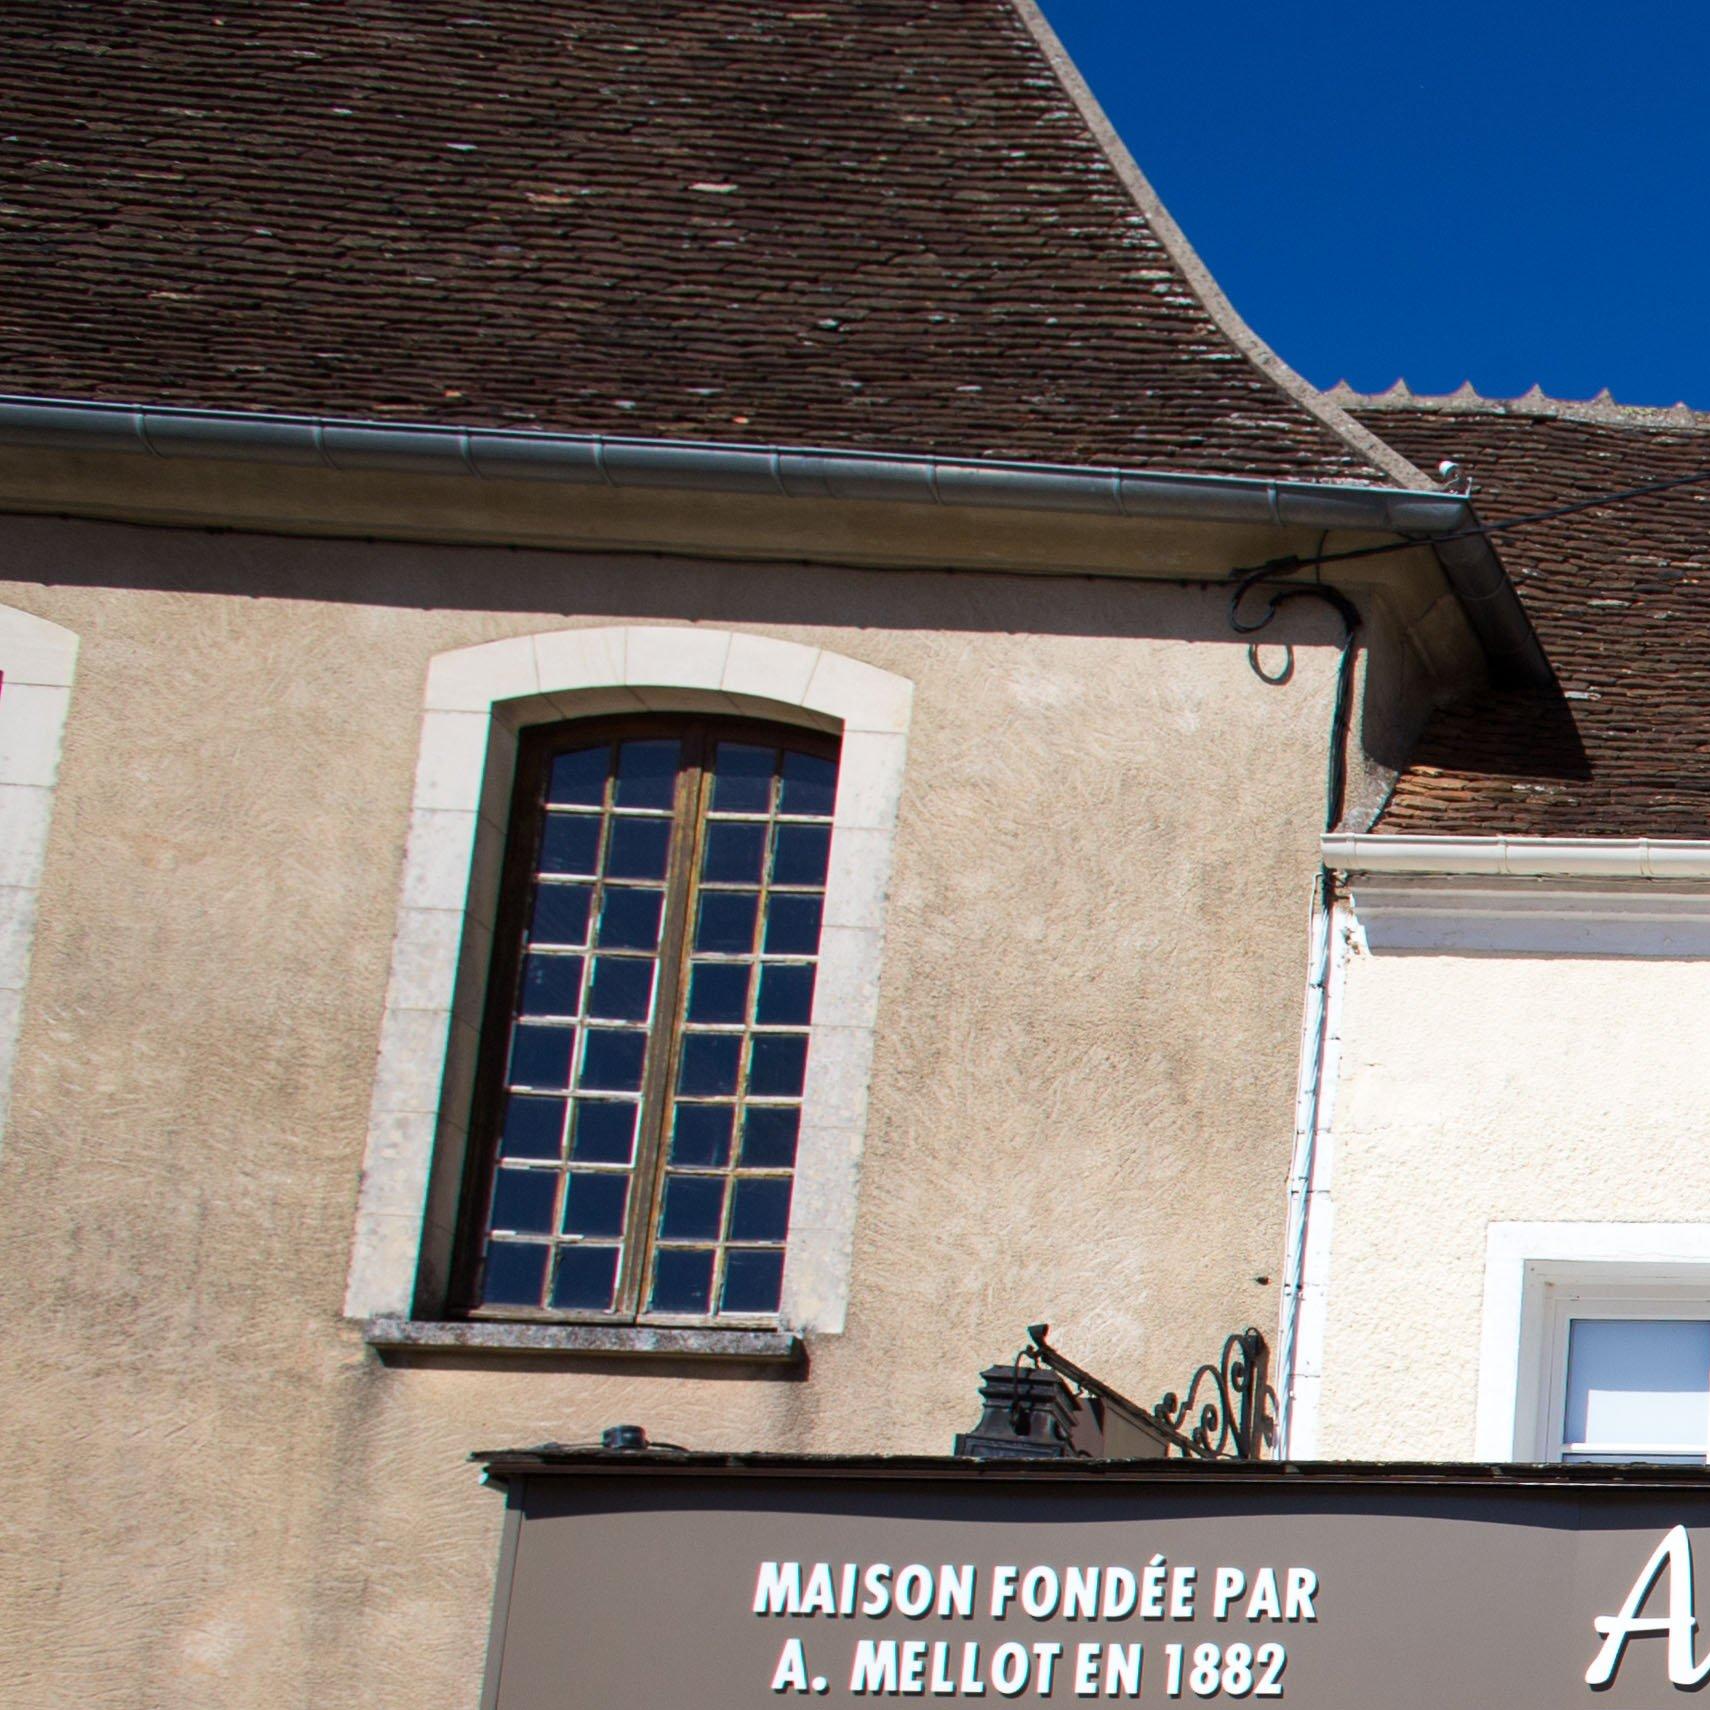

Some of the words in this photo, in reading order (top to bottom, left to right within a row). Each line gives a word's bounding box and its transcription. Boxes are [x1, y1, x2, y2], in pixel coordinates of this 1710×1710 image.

[752, 1561, 974, 1616] MAISON
[990, 1552, 1197, 1618] FONDÉE
[1212, 1566, 1317, 1619] PAR
[770, 1638, 827, 1691] A.
[849, 1639, 1062, 1695] MELLOT
[1074, 1642, 1141, 1696] EN
[1164, 1642, 1285, 1696] 1882
